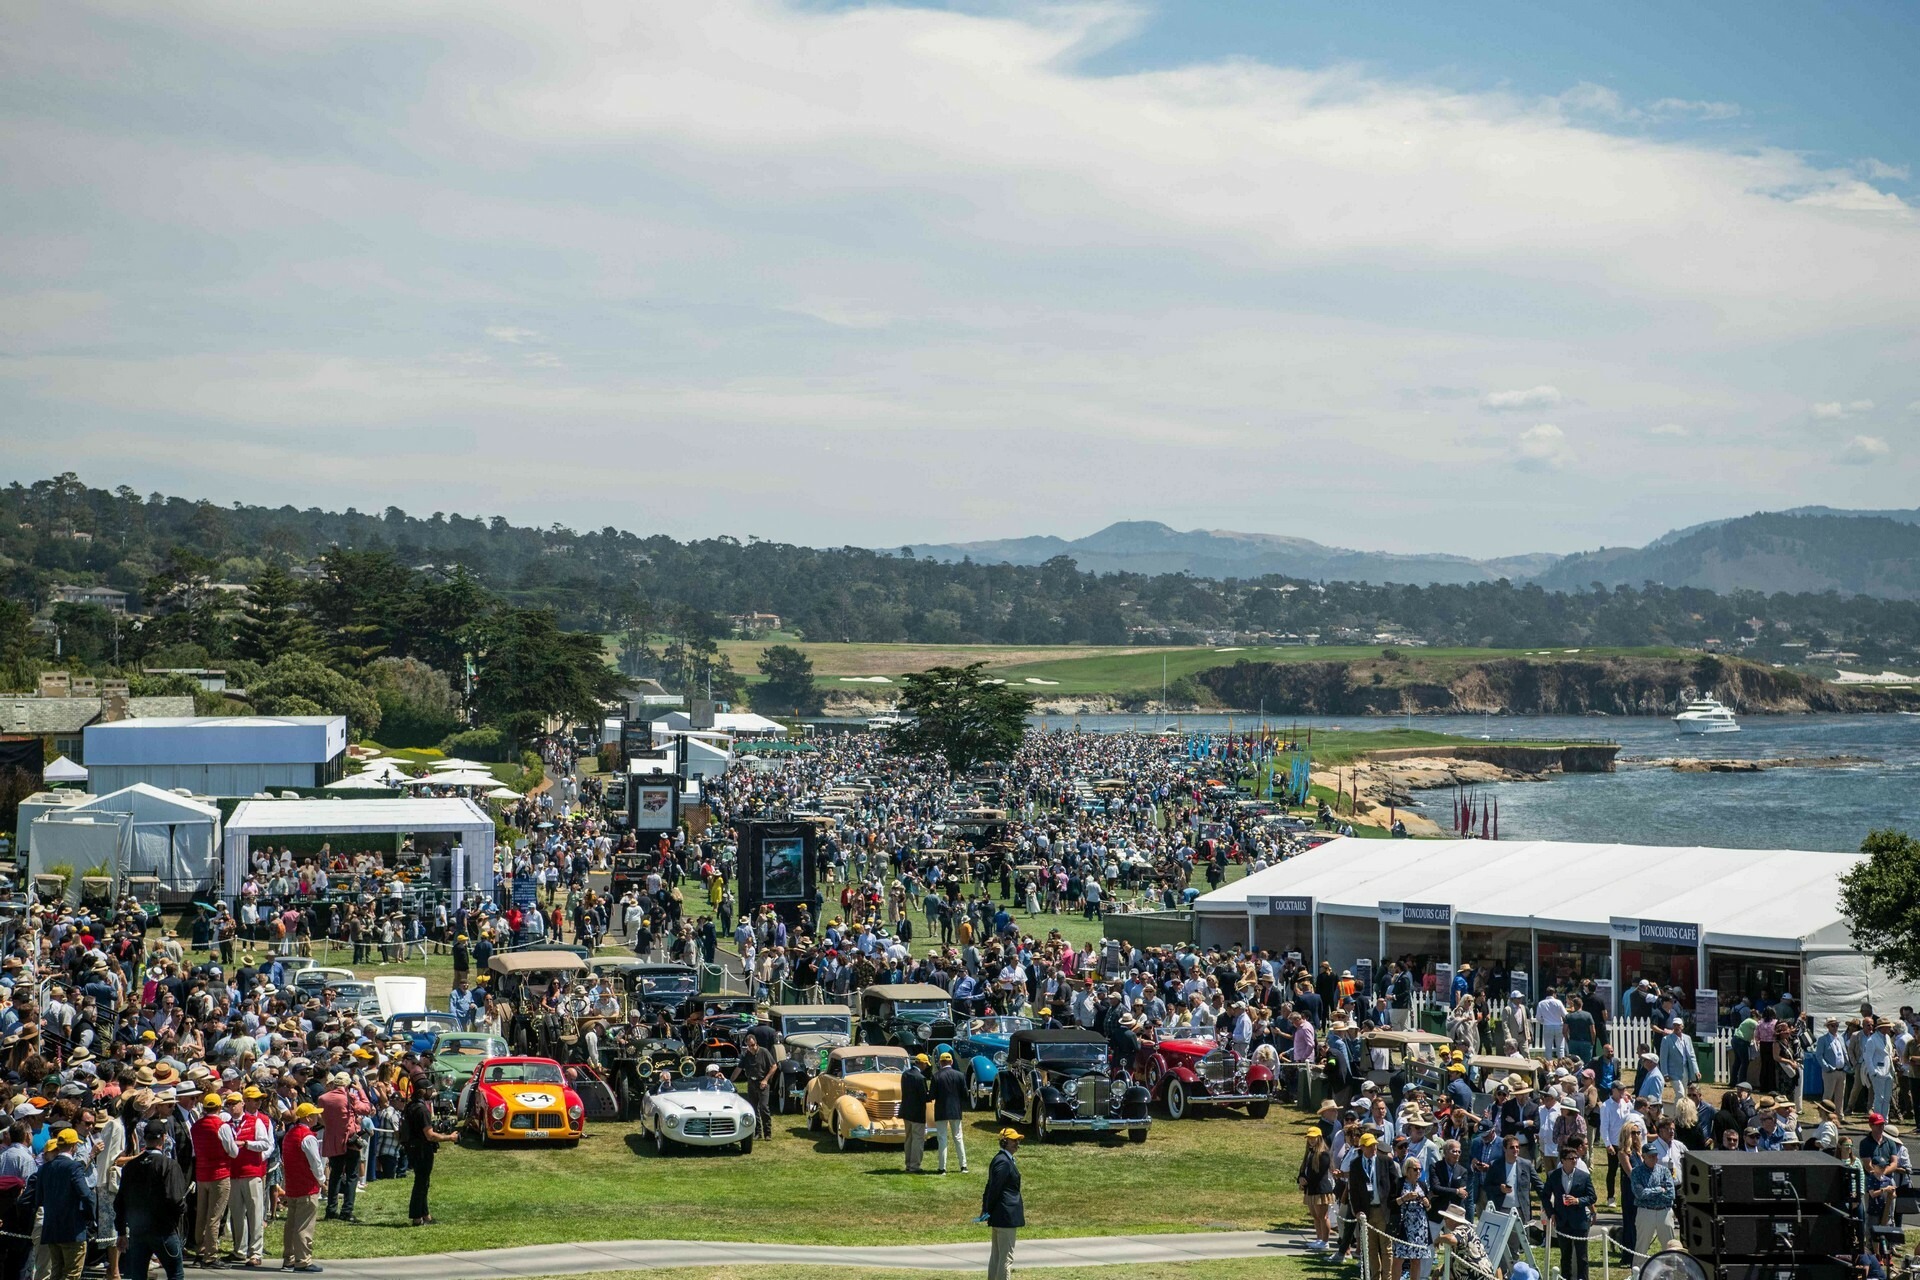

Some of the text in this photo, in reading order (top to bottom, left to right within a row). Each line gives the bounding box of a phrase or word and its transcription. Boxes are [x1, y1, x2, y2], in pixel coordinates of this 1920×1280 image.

[1275, 900, 1307, 911] COCKTAILS
[1404, 907, 1450, 920] CONCOURS CAFÉ
[1641, 924, 1697, 940] CONCOURS CAFÉ
[521, 1094, 553, 1103] 54
